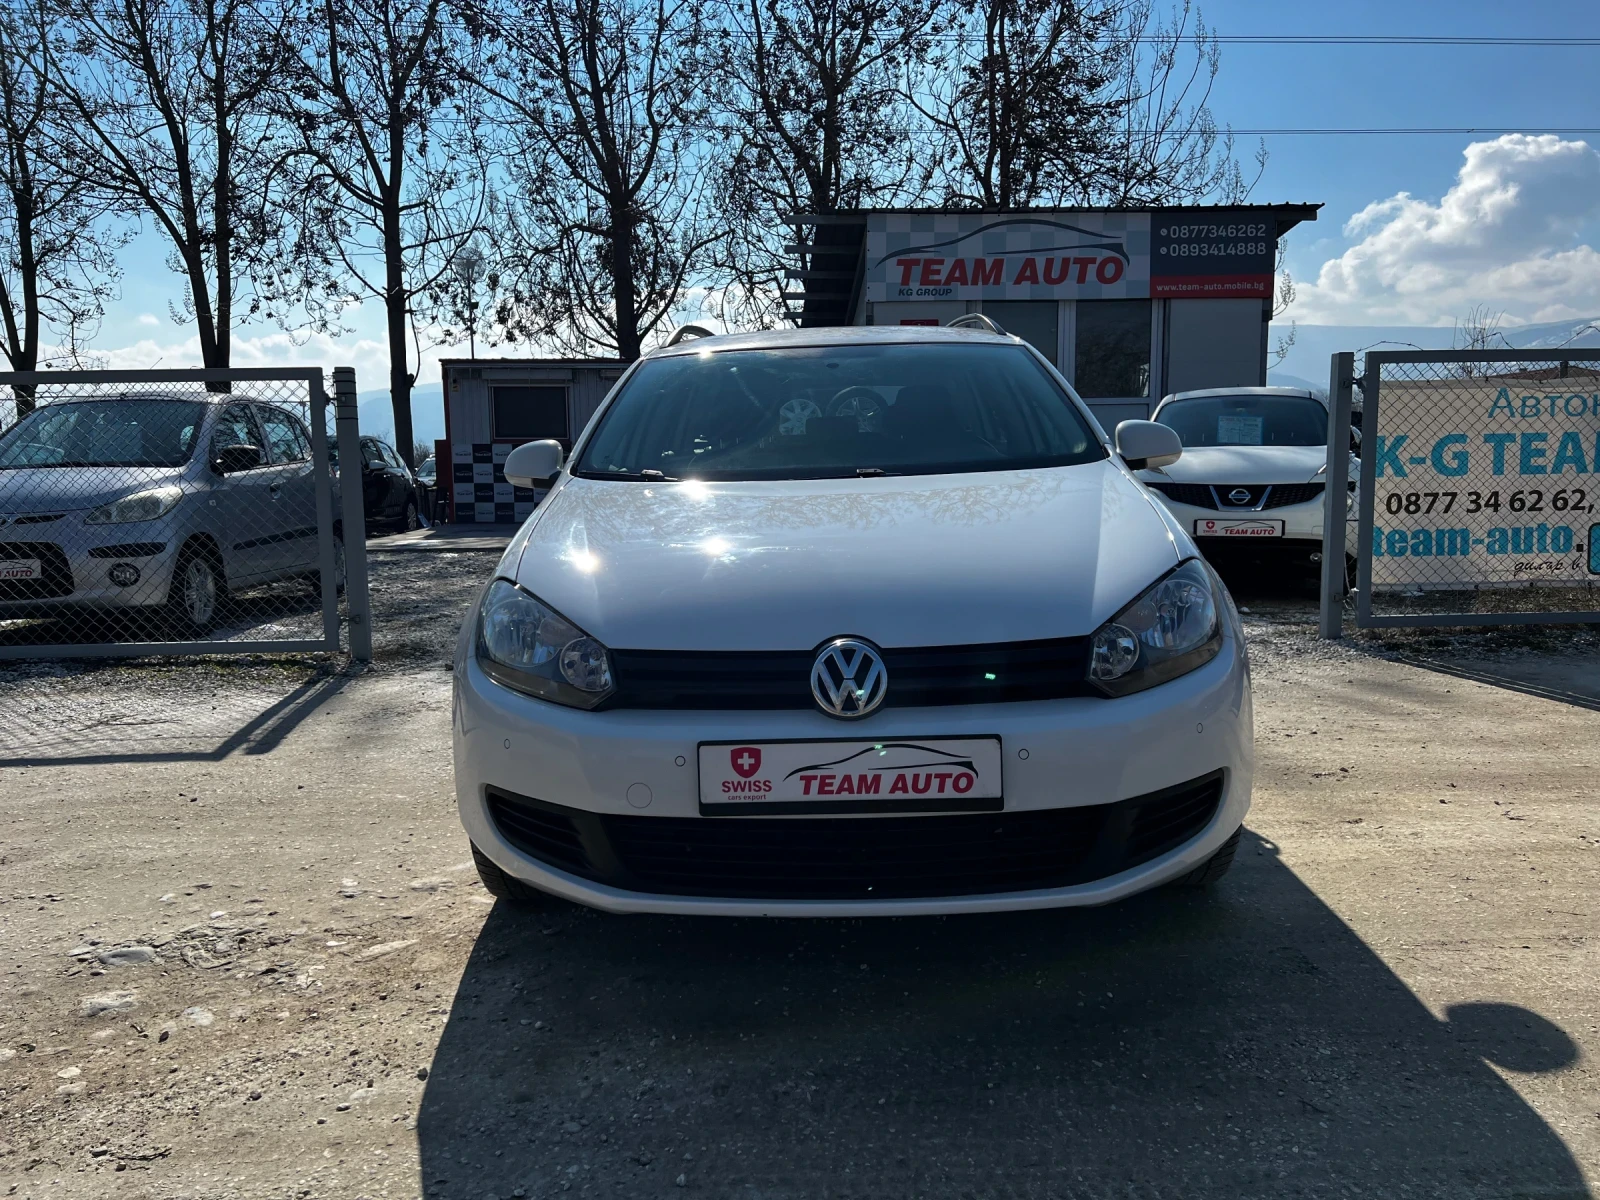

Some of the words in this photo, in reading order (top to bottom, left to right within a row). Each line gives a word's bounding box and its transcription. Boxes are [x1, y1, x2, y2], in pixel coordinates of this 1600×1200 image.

[1169, 224, 1267, 238] 0877346262
[1169, 242, 1267, 257] 0893414888
[896, 257, 1005, 287] TEAM
[1012, 255, 1125, 286] AUTO
[898, 288, 913, 297] KG
[916, 287, 953, 297] GROUP
[1156, 281, 1265, 291] www.team-auto.mobile.bg
[1374, 433, 1470, 479] K-G
[1385, 491, 1458, 515] 0877
[1466, 490, 1501, 514] 34
[1509, 489, 1545, 513] 62
[1551, 488, 1595, 515] 62,
[3, 569, 33, 578] AUTO
[721, 779, 773, 793] SWISS
[799, 773, 882, 796] TEAM
[888, 772, 975, 795] AUTO
[743, 793, 767, 802] export
